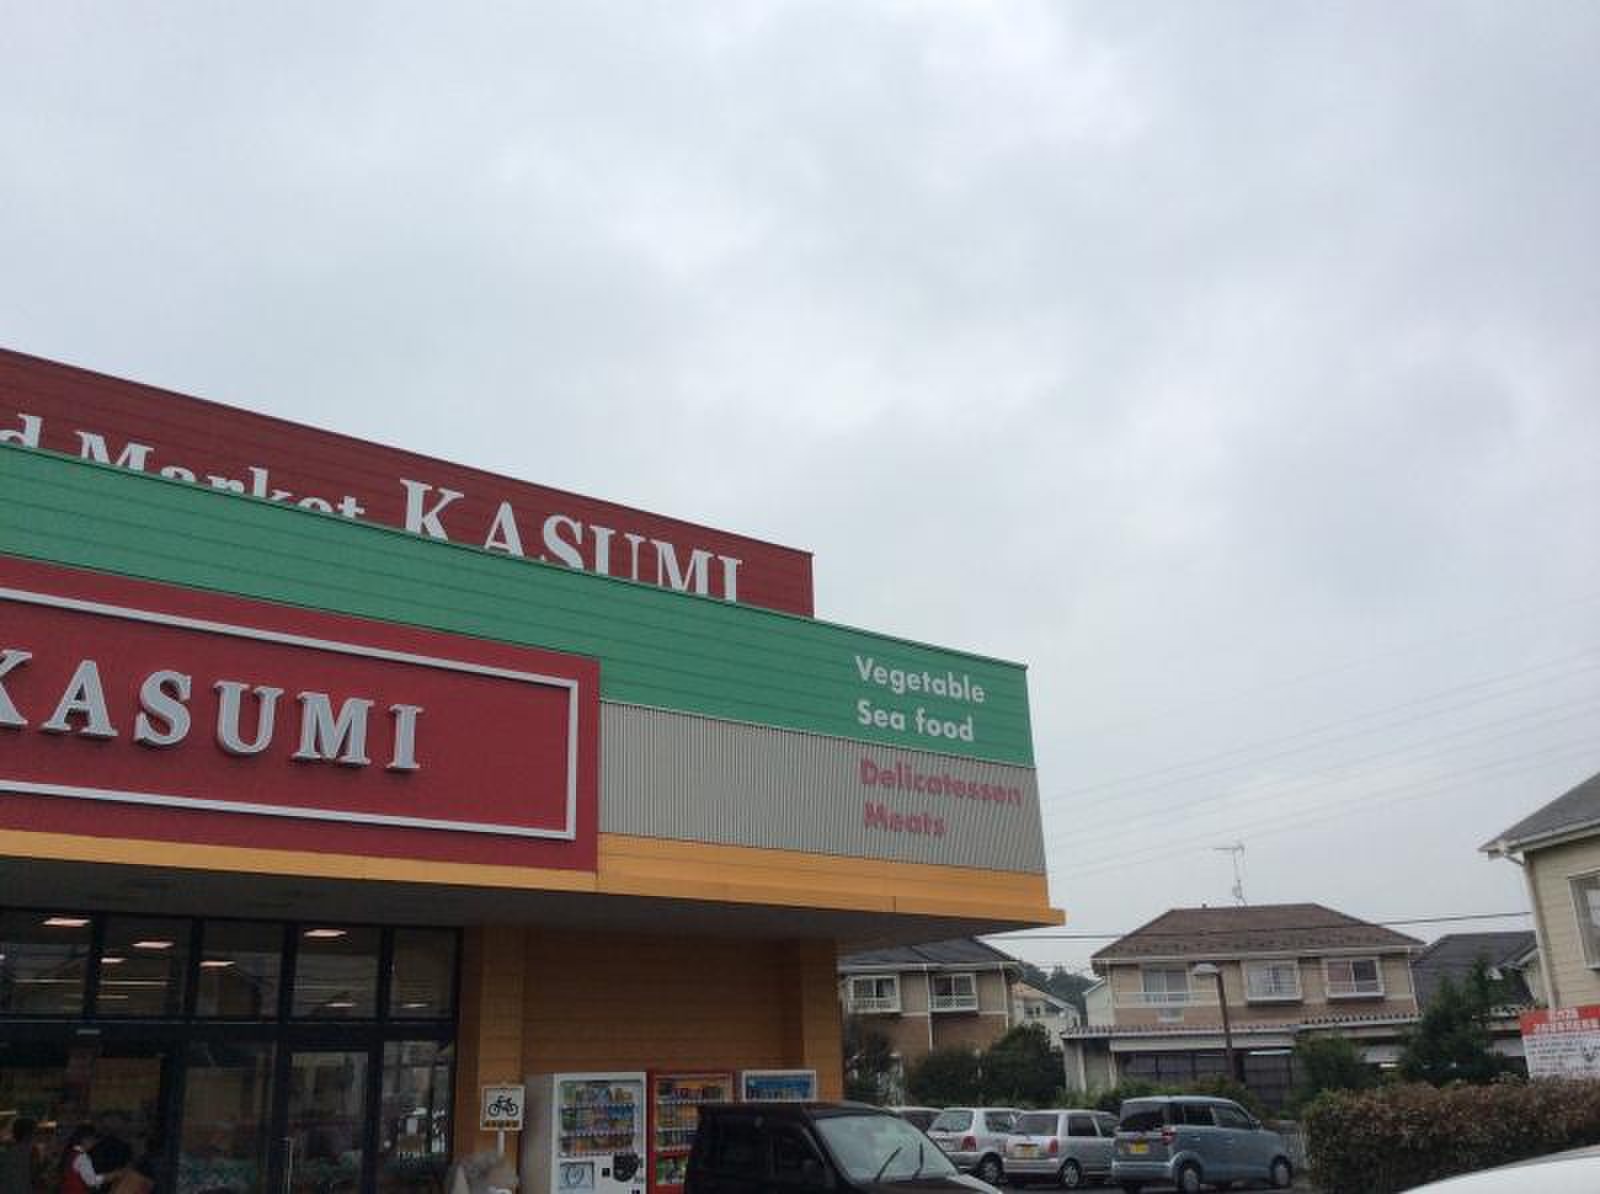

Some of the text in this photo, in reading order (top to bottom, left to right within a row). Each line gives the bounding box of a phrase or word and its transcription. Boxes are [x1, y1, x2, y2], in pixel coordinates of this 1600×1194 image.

[400, 478, 743, 603] KASUMI
[855, 655, 986, 703] Vegetable
[857, 700, 974, 741] Sea food
[860, 757, 1024, 807] Delicatessen
[863, 802, 948, 838] Meats
